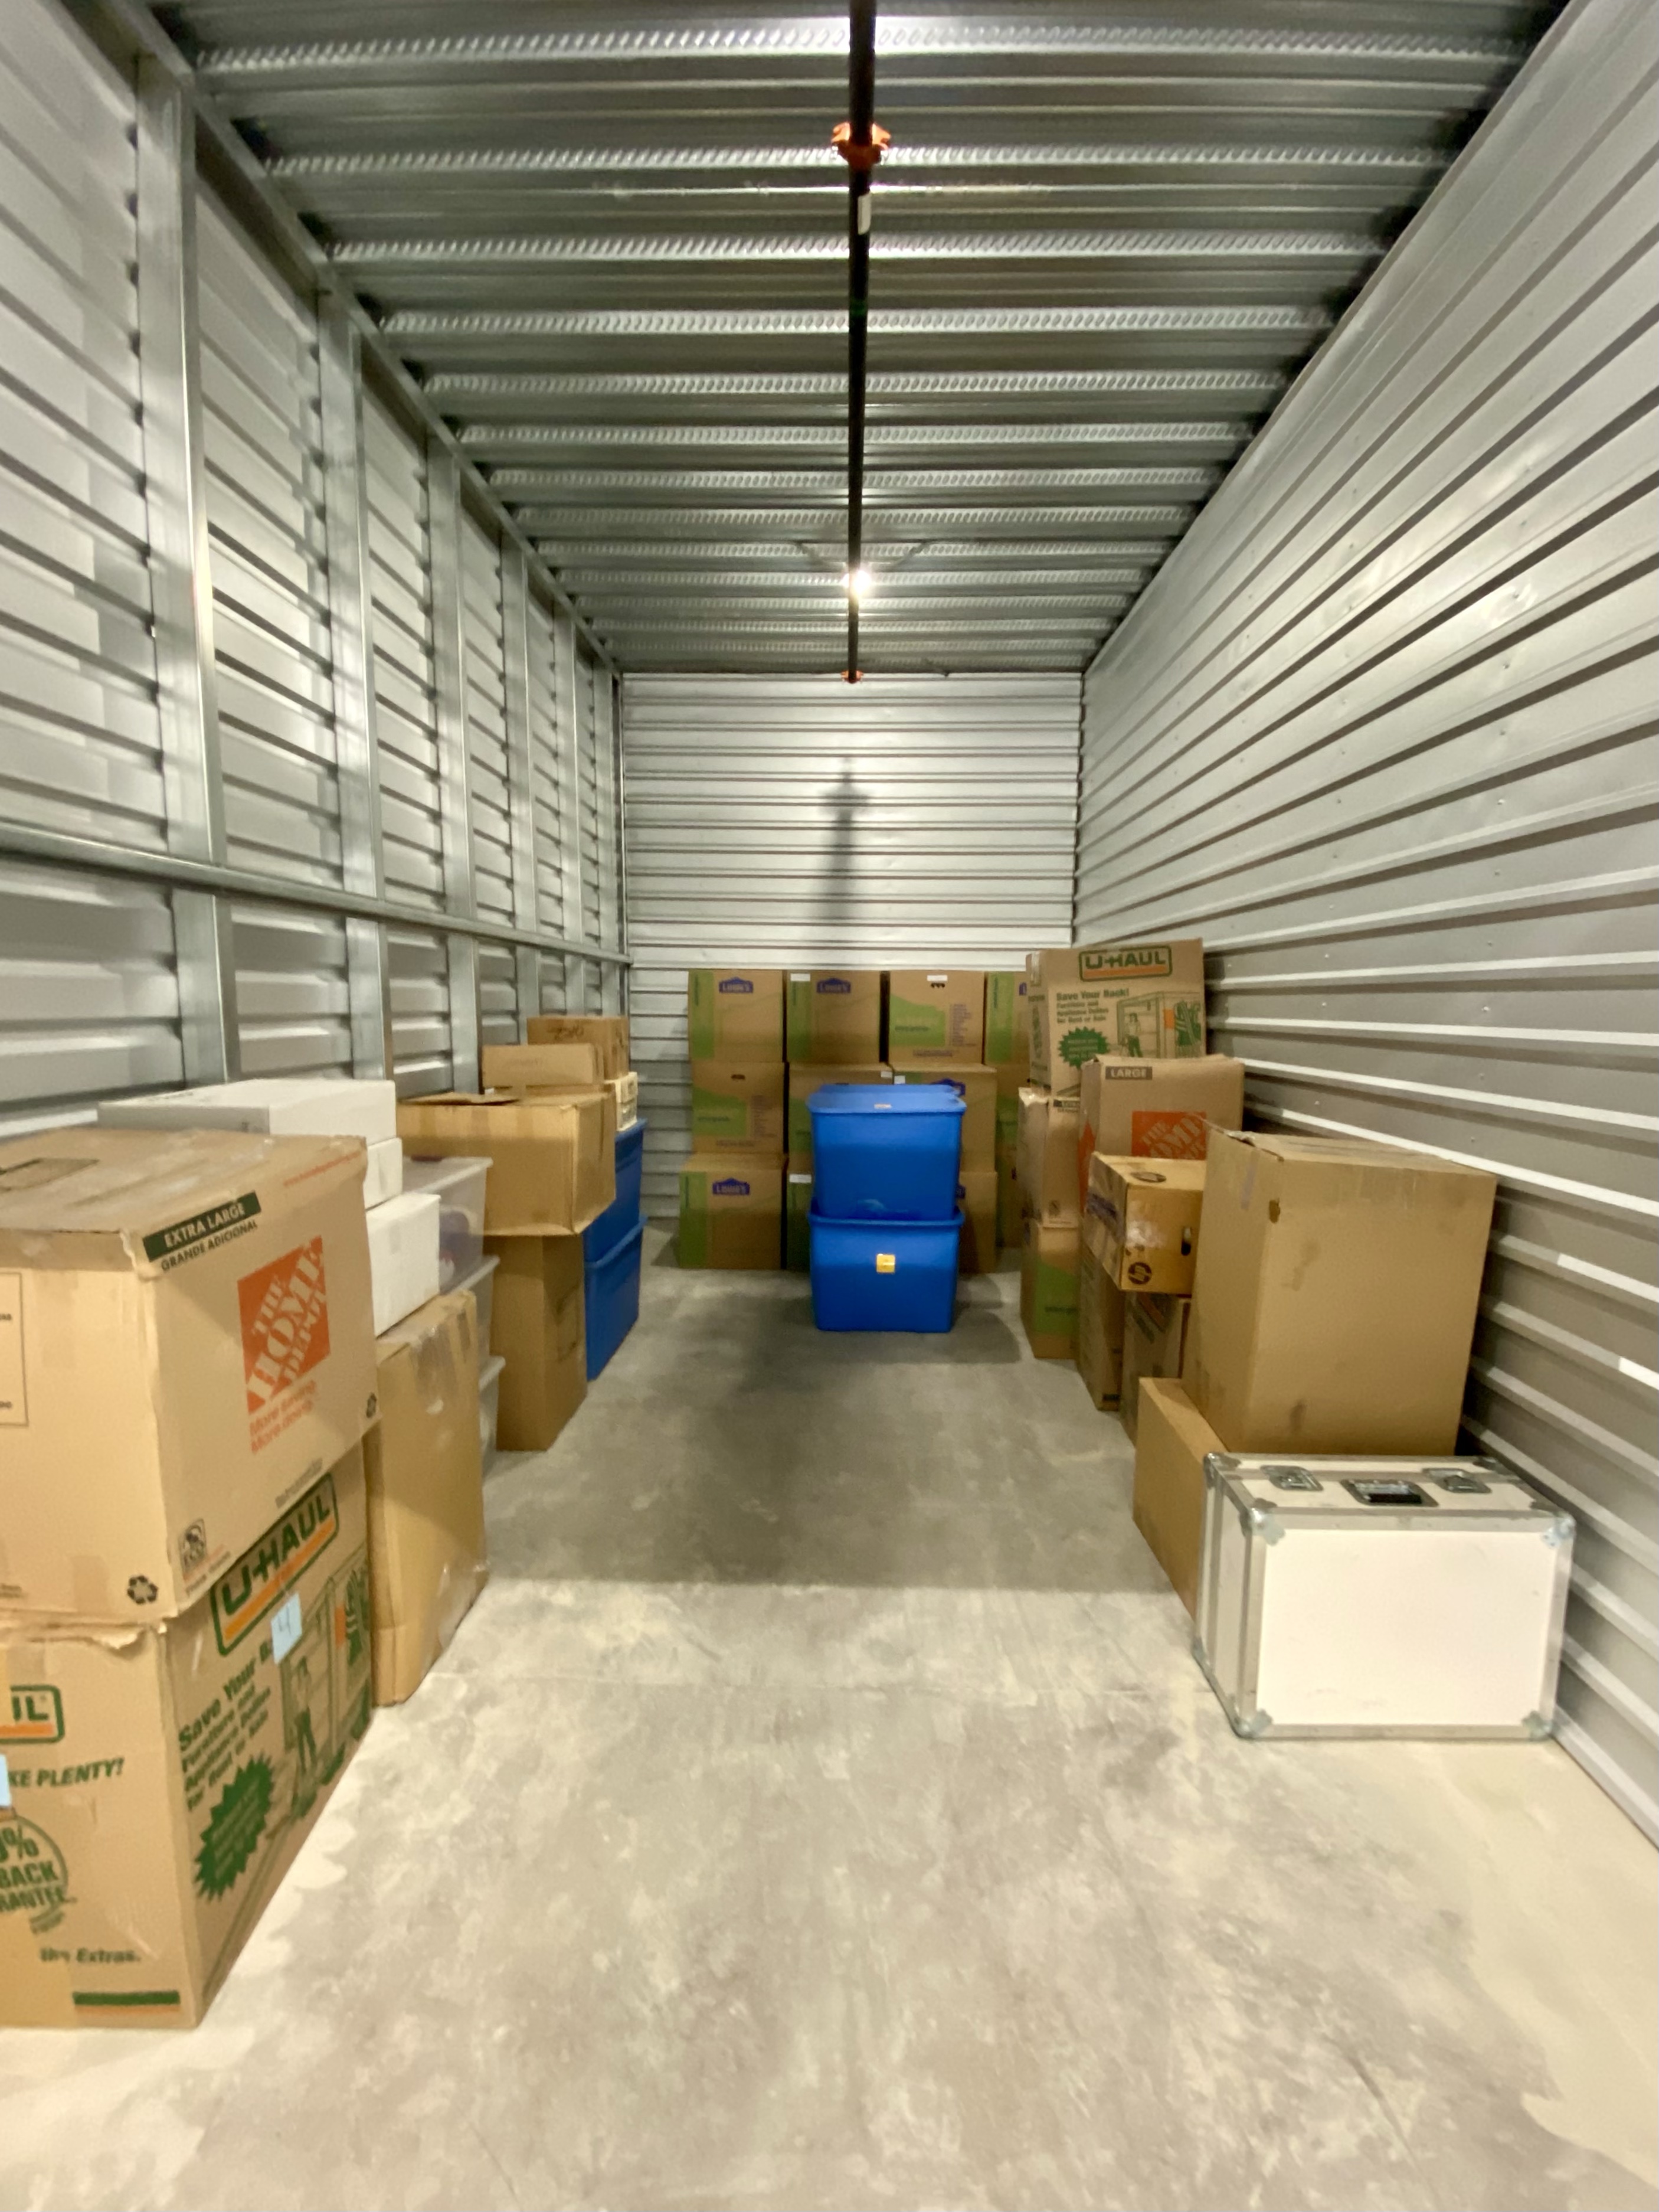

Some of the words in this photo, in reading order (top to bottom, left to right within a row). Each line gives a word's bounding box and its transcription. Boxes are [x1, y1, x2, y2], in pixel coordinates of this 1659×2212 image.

[1085, 950, 1167, 969] U-HAUL
[1056, 992, 1078, 1001] Save
[1081, 991, 1100, 999] Your
[1110, 1068, 1147, 1078] LARGE
[161, 1241, 205, 1271] GRANDE
[208, 1218, 258, 1252] ADICIONAL
[164, 1221, 206, 1249] EXTRA
[207, 1202, 246, 1227] LARGE
[247, 1246, 323, 1397] HOME
[251, 1274, 284, 1335] THE
[221, 1494, 331, 1615] U-HAUL
[178, 1698, 221, 1752] Save
[224, 1657, 256, 1702] Your
[8, 1769, 31, 1787] KE
[37, 1756, 125, 1788] PLENTY!
